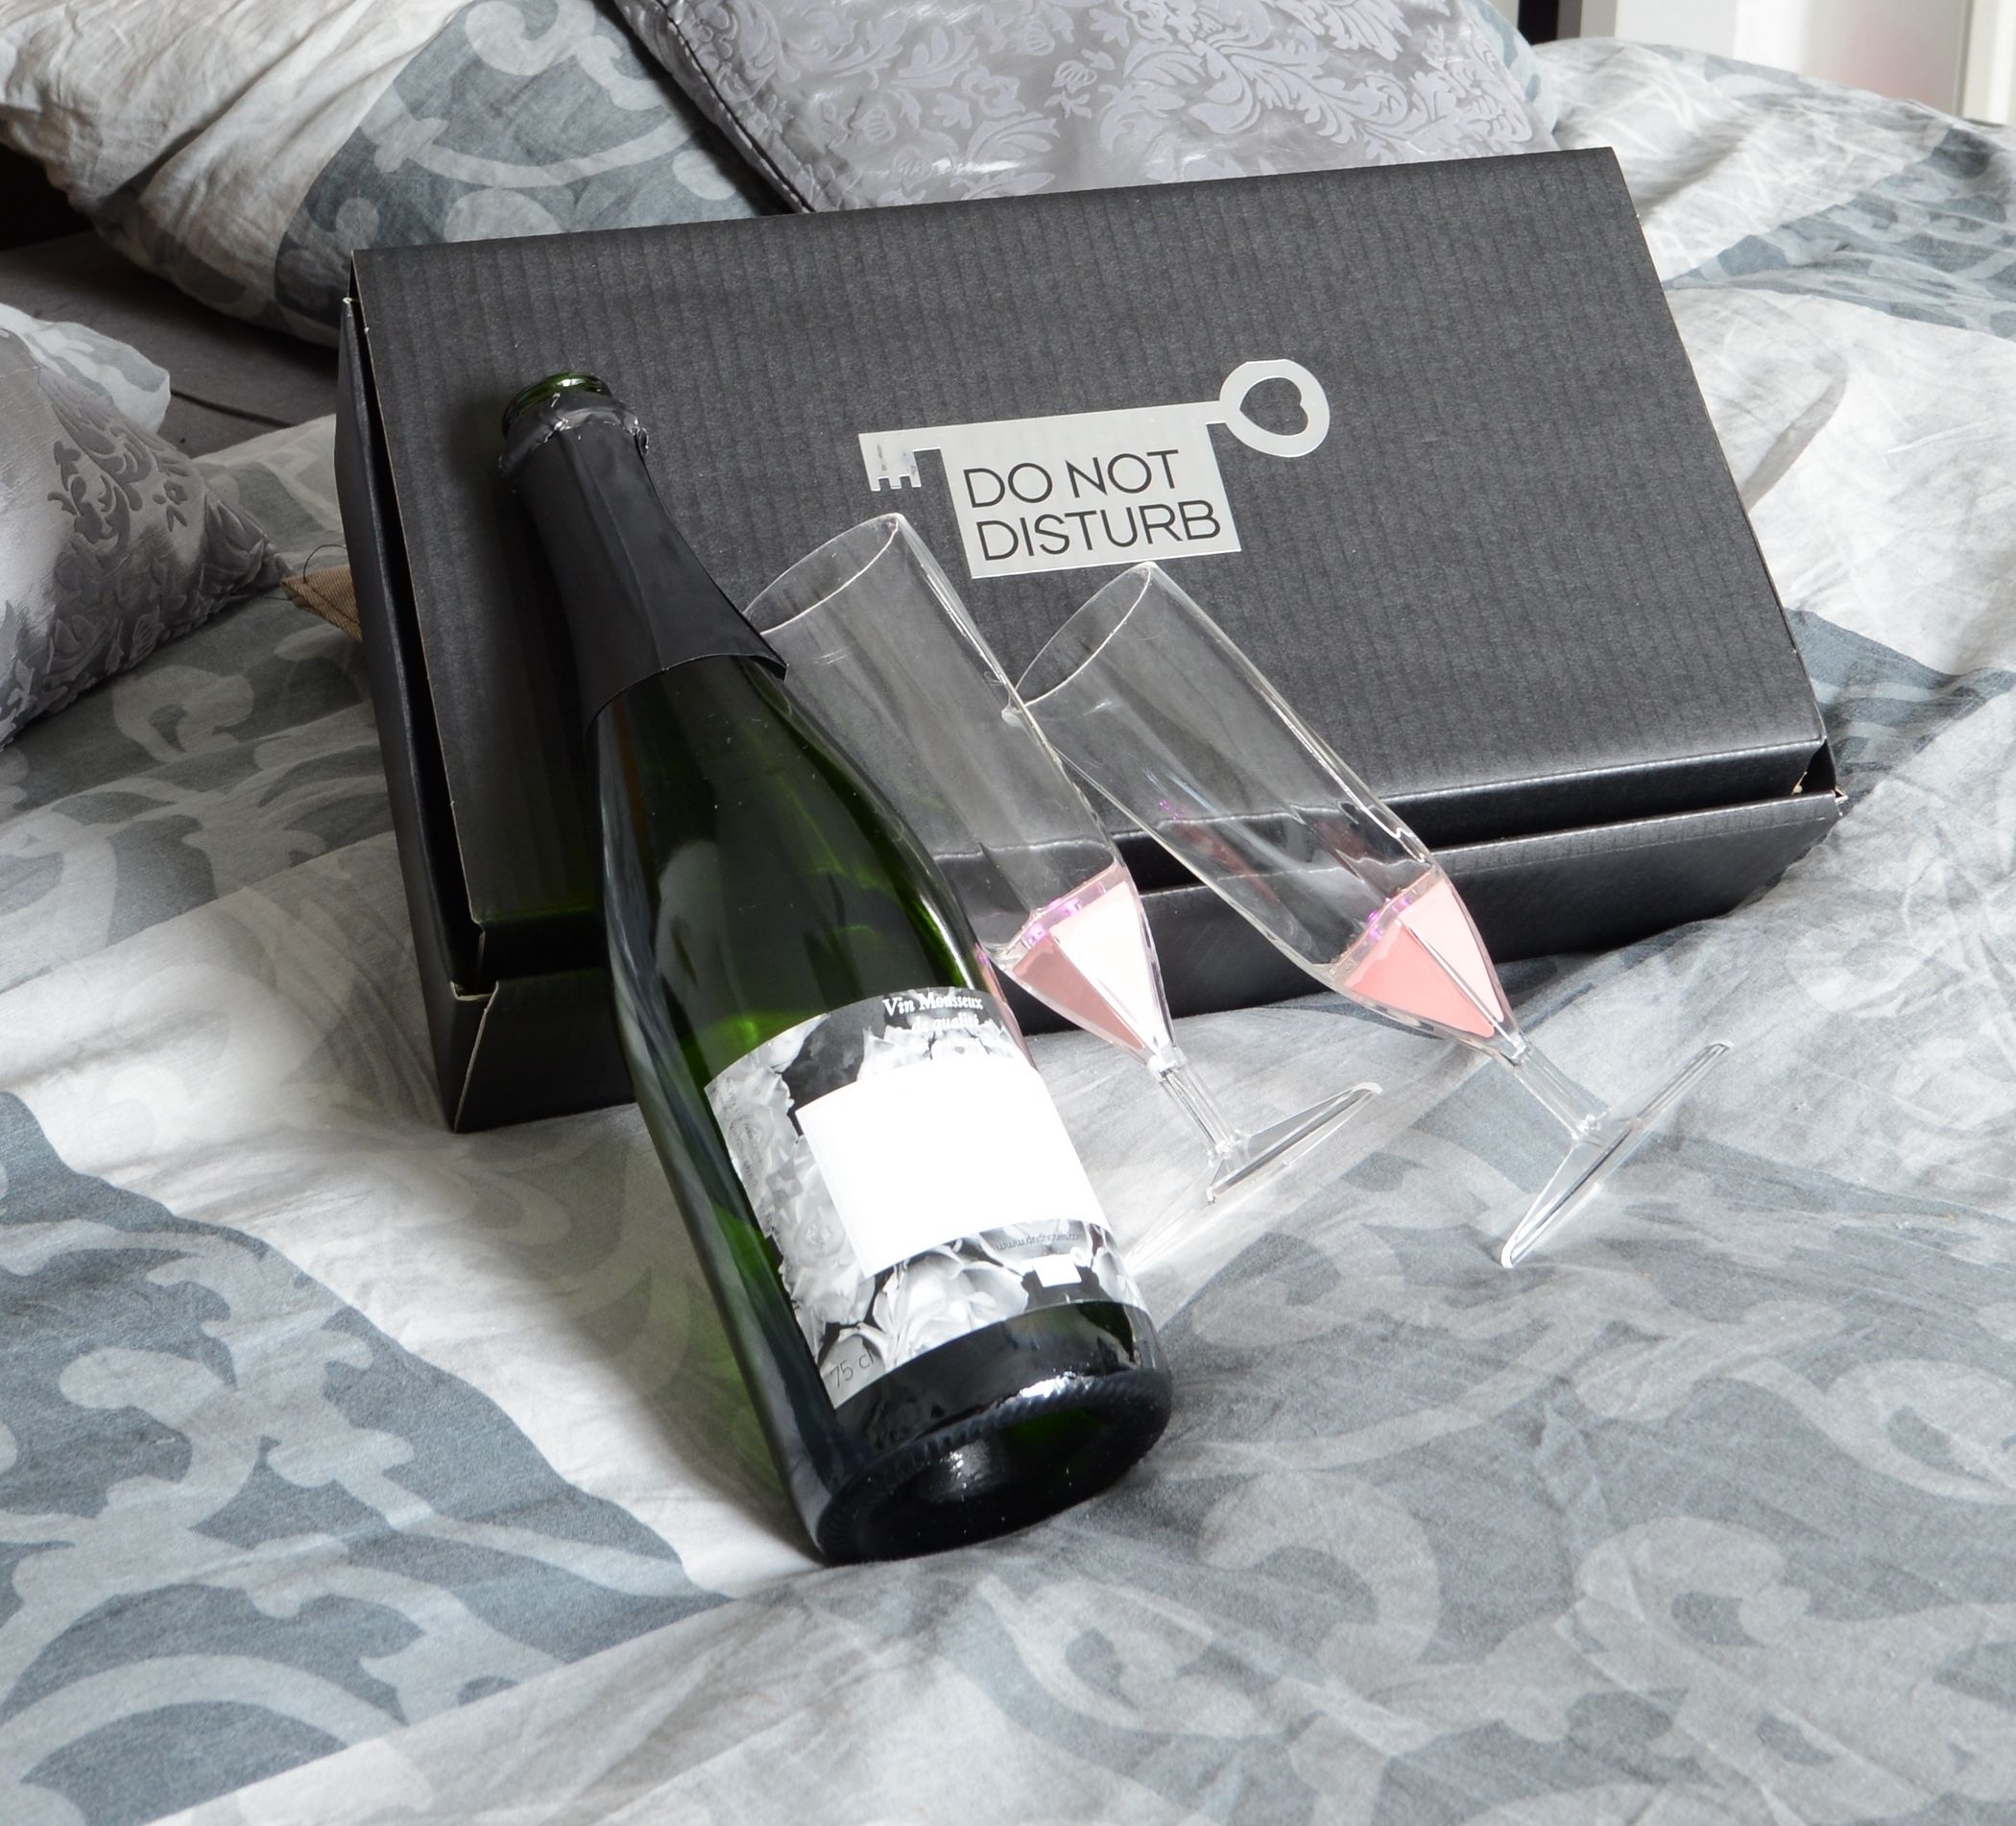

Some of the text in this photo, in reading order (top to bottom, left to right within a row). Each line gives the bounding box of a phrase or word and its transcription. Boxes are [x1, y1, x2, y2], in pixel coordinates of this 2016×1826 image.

[963, 448, 1179, 508] DO NOT
[976, 499, 1221, 561] DISTURB
[881, 992, 984, 1018] Vin Mousseux
[912, 1015, 929, 1033] de
[829, 1348, 875, 1388] 75 cl
